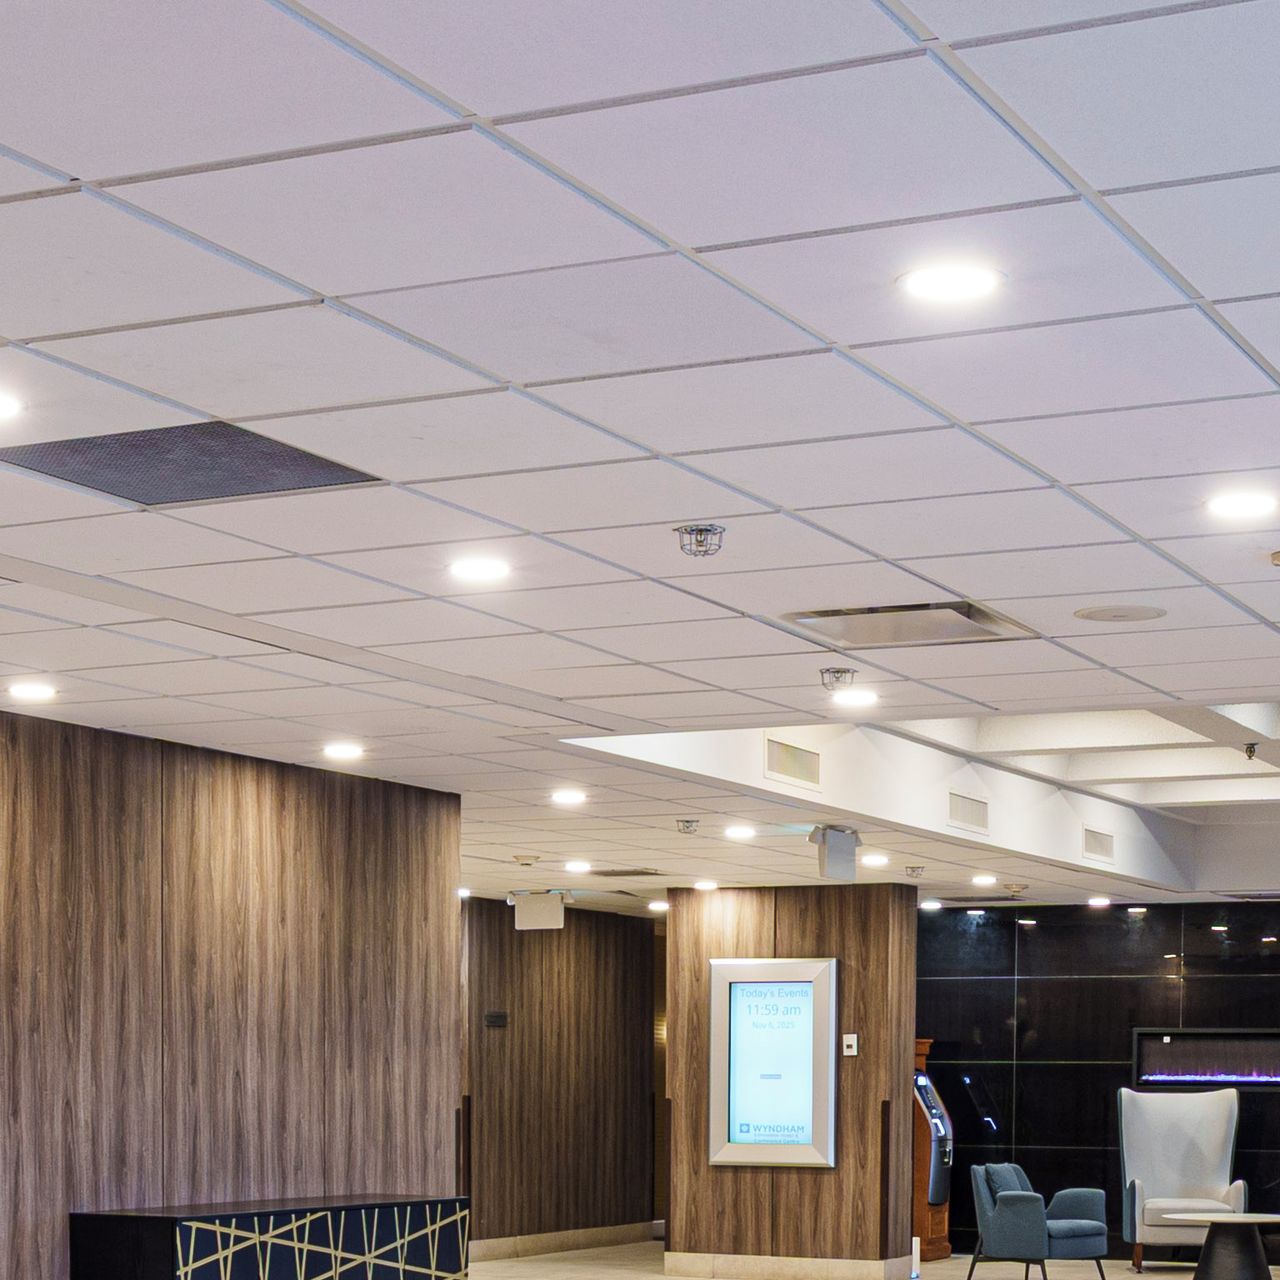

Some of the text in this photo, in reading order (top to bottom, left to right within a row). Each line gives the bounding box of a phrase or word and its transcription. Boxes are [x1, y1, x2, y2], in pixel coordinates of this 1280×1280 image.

[740, 988, 809, 999] Today's Events
[747, 1004, 801, 1016] 11:59 am
[753, 1124, 805, 1133] WYNDHAM
